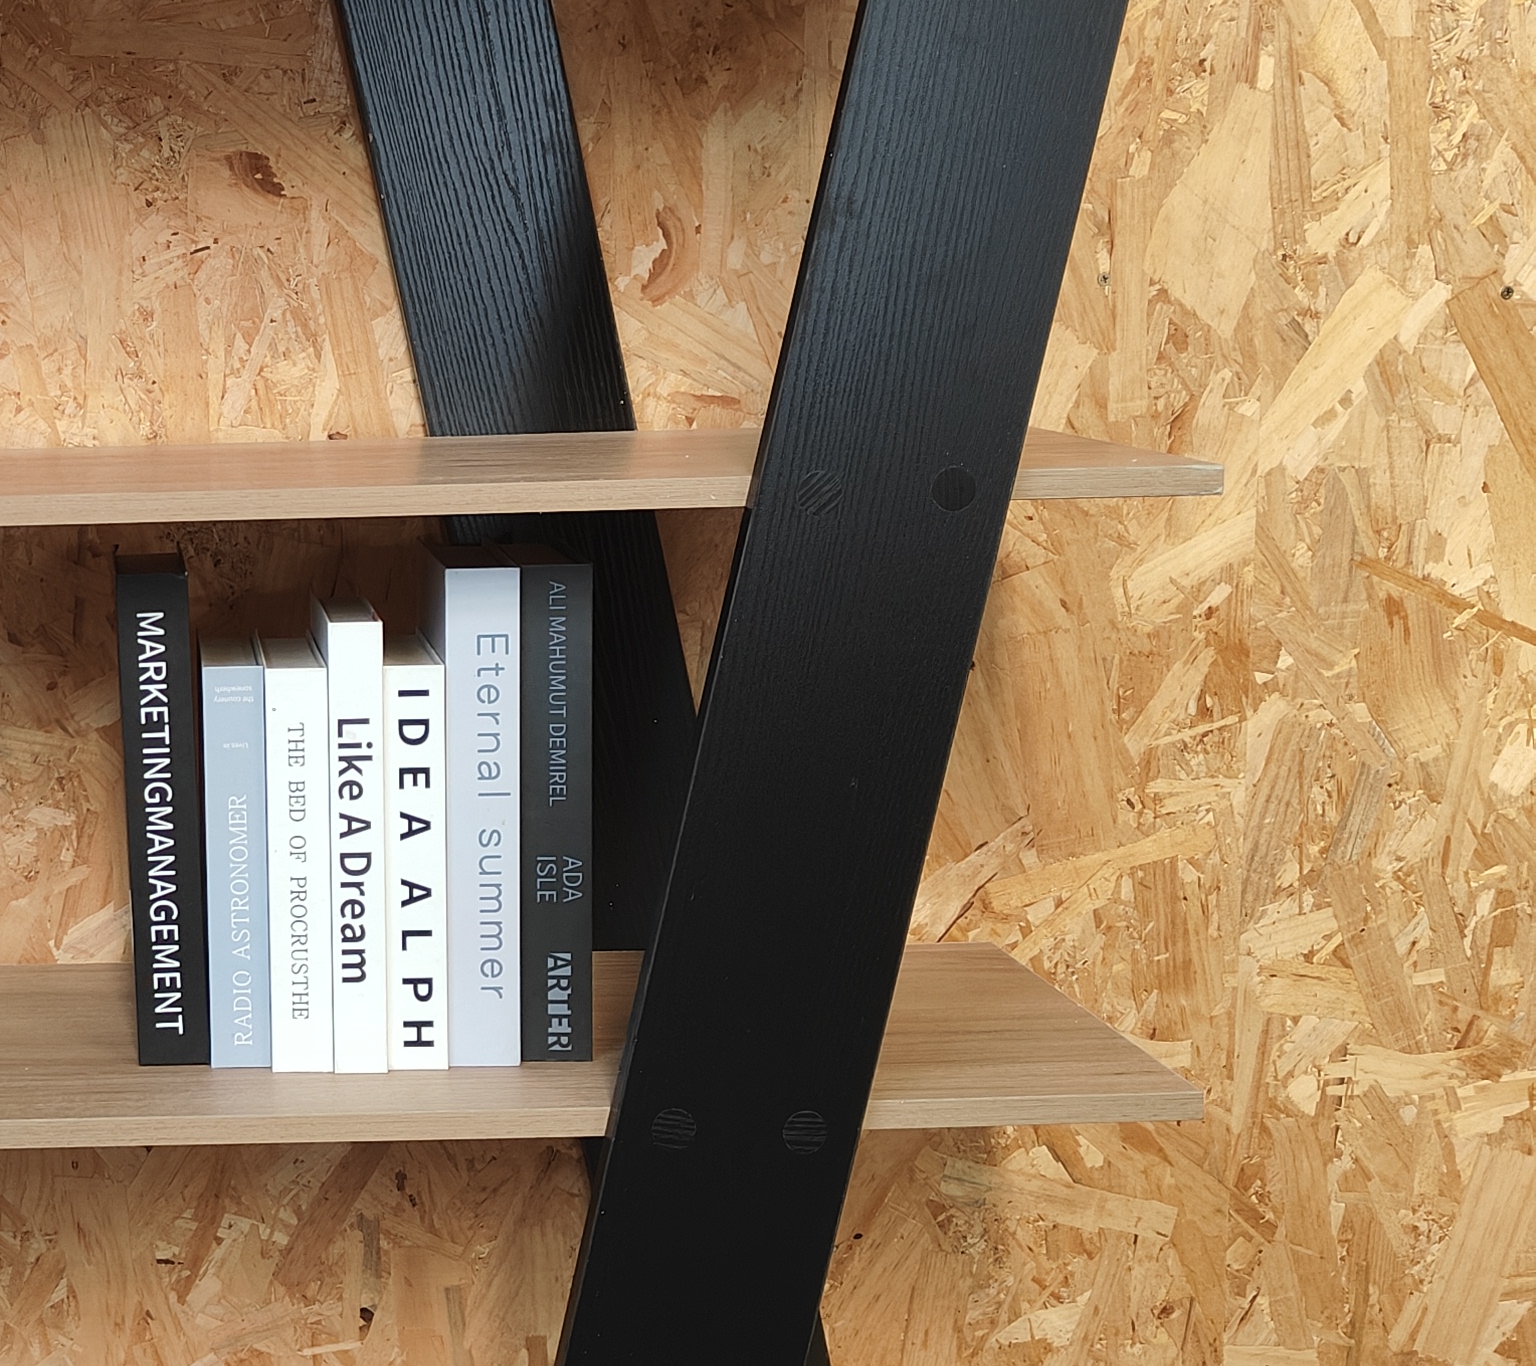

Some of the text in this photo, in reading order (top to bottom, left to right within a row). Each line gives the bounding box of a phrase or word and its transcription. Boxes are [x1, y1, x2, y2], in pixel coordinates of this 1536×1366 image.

[243, 695, 255, 704] the
[475, 633, 512, 999] Eternal summer
[548, 580, 567, 808] ALI MAHUMUT DEMIREL
[135, 611, 184, 1035] MARKETINGMANAGEMENT
[228, 794, 253, 1047] RADIO ASTRONOMER
[287, 722, 310, 1020] THE BED OF PROCRUSTHE
[337, 717, 374, 984] Like A Dream
[397, 689, 435, 1048] IDEA ALPH
[535, 856, 557, 904] ISLE
[562, 856, 584, 903] ADA
[546, 952, 573, 1051] ARTER
